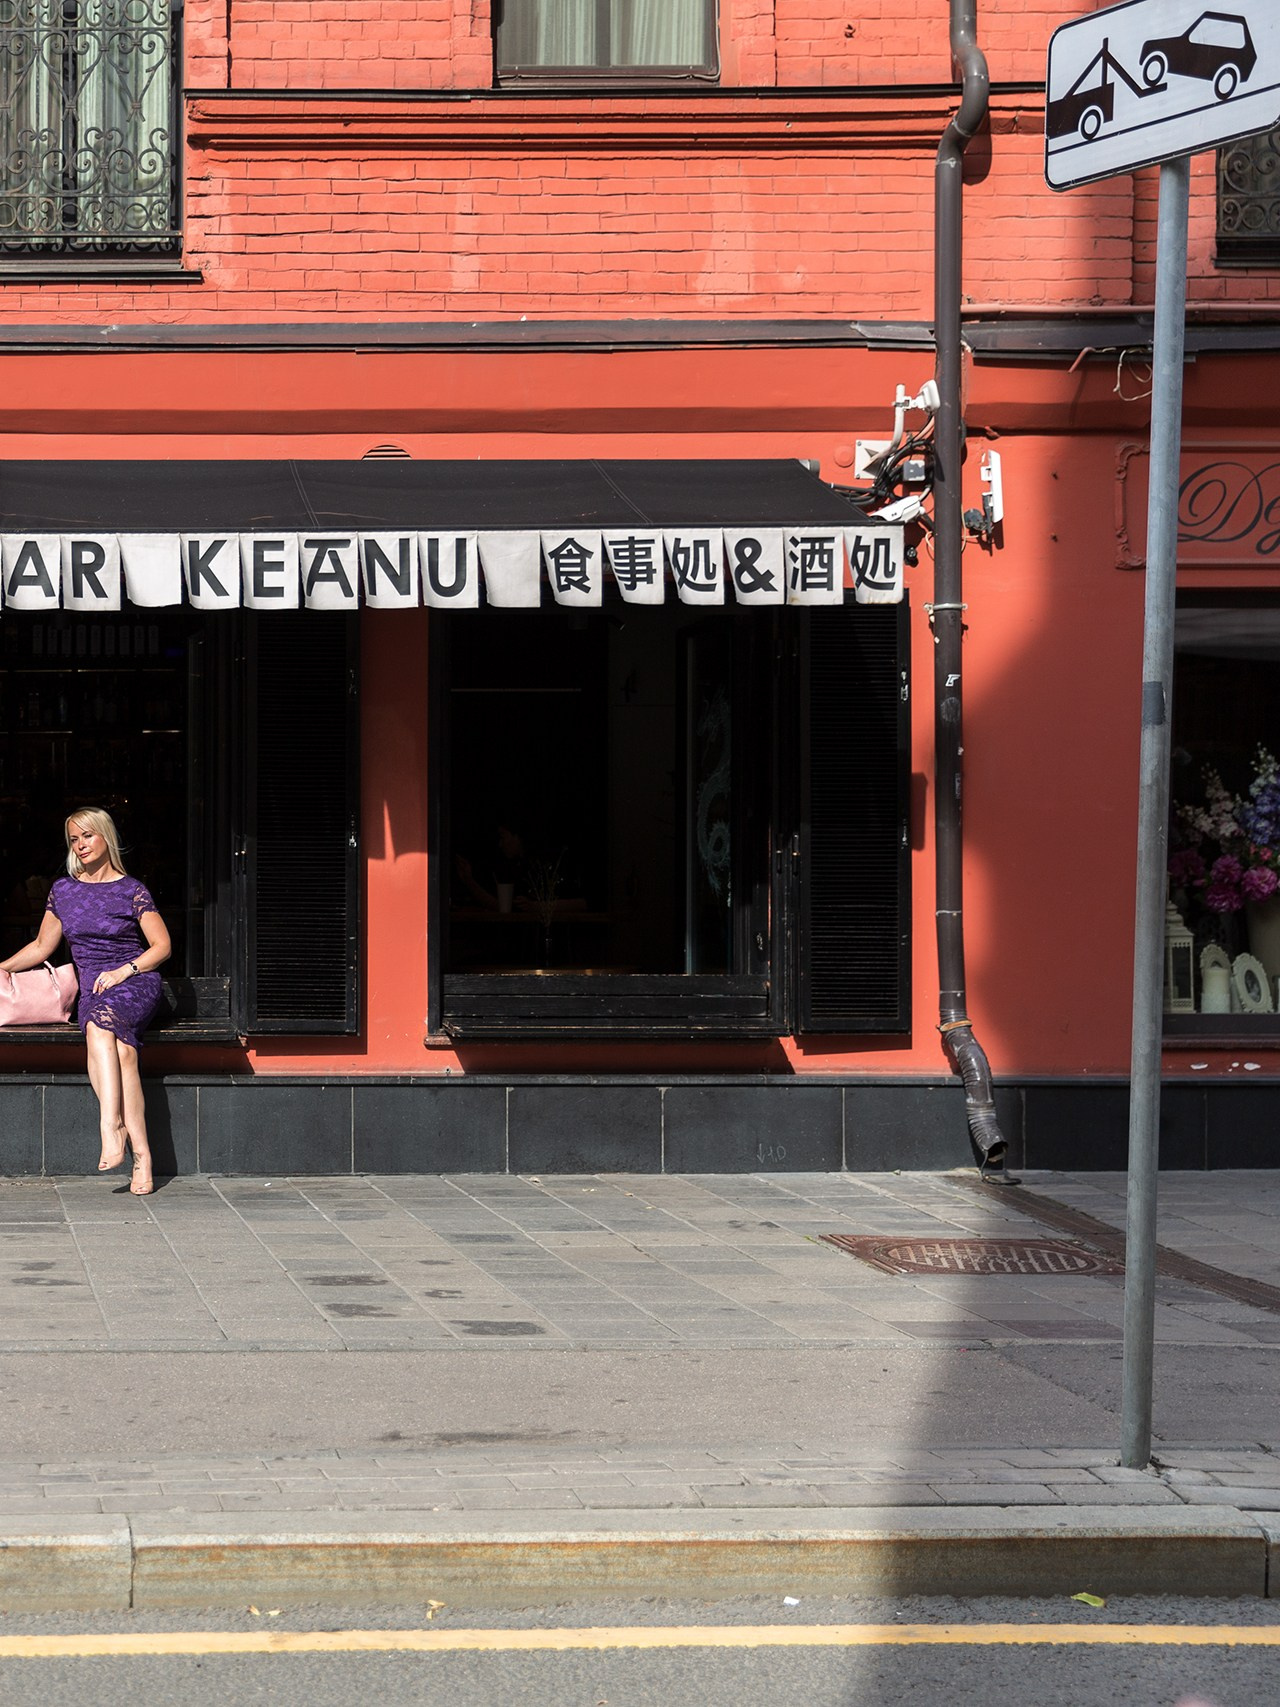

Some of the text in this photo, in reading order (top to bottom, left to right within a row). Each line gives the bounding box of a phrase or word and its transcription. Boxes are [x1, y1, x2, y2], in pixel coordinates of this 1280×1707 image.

[547, 535, 898, 594] 食事処&酒処
